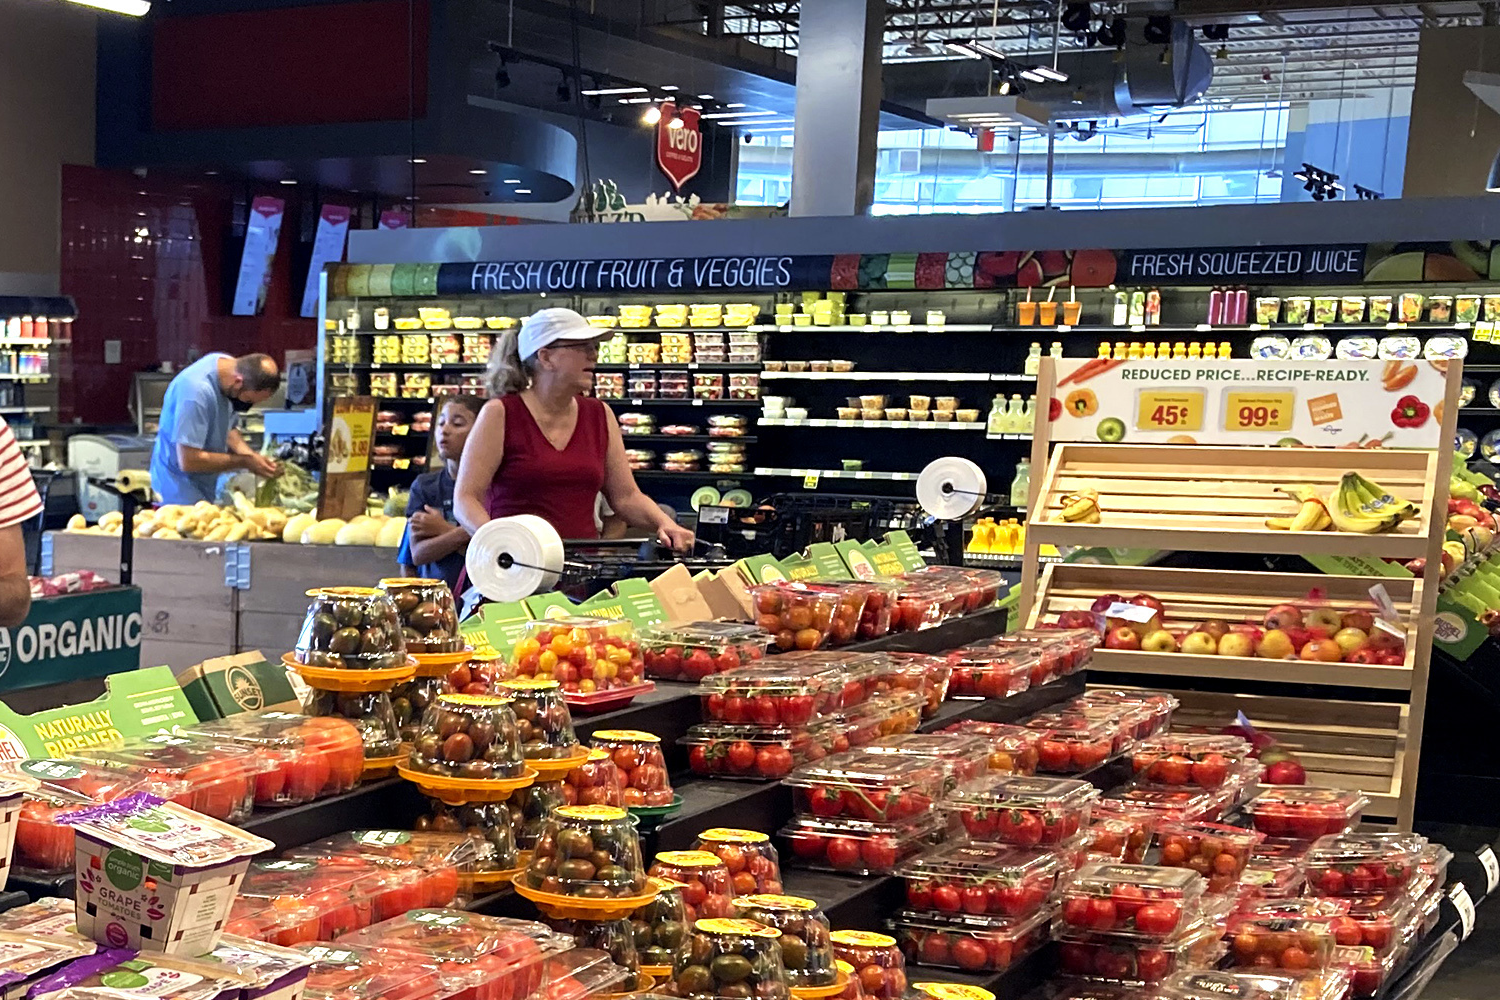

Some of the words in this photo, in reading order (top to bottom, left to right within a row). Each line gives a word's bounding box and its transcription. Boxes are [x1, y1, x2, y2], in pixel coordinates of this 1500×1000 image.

[668, 127, 698, 153] vero
[470, 261, 542, 291] FRESH
[546, 260, 596, 289] CUT
[596, 258, 664, 288] FRUIT
[667, 258, 685, 288] &
[693, 256, 794, 287] VEGGIES
[1131, 253, 1193, 277] FRESH
[1197, 251, 1301, 275] SQUEEZED
[1306, 249, 1361, 273] JUICE
[1121, 368, 1191, 381] REDUCED
[16, 611, 143, 664] ORGANIC
[234, 684, 261, 702] SUNSET
[33, 709, 115, 743] NATURALLY
[45, 727, 123, 760] RIPENED
[107, 862, 141, 881] organic
[96, 896, 142, 920] TOMATOES
[98, 885, 143, 910] GRAPE
